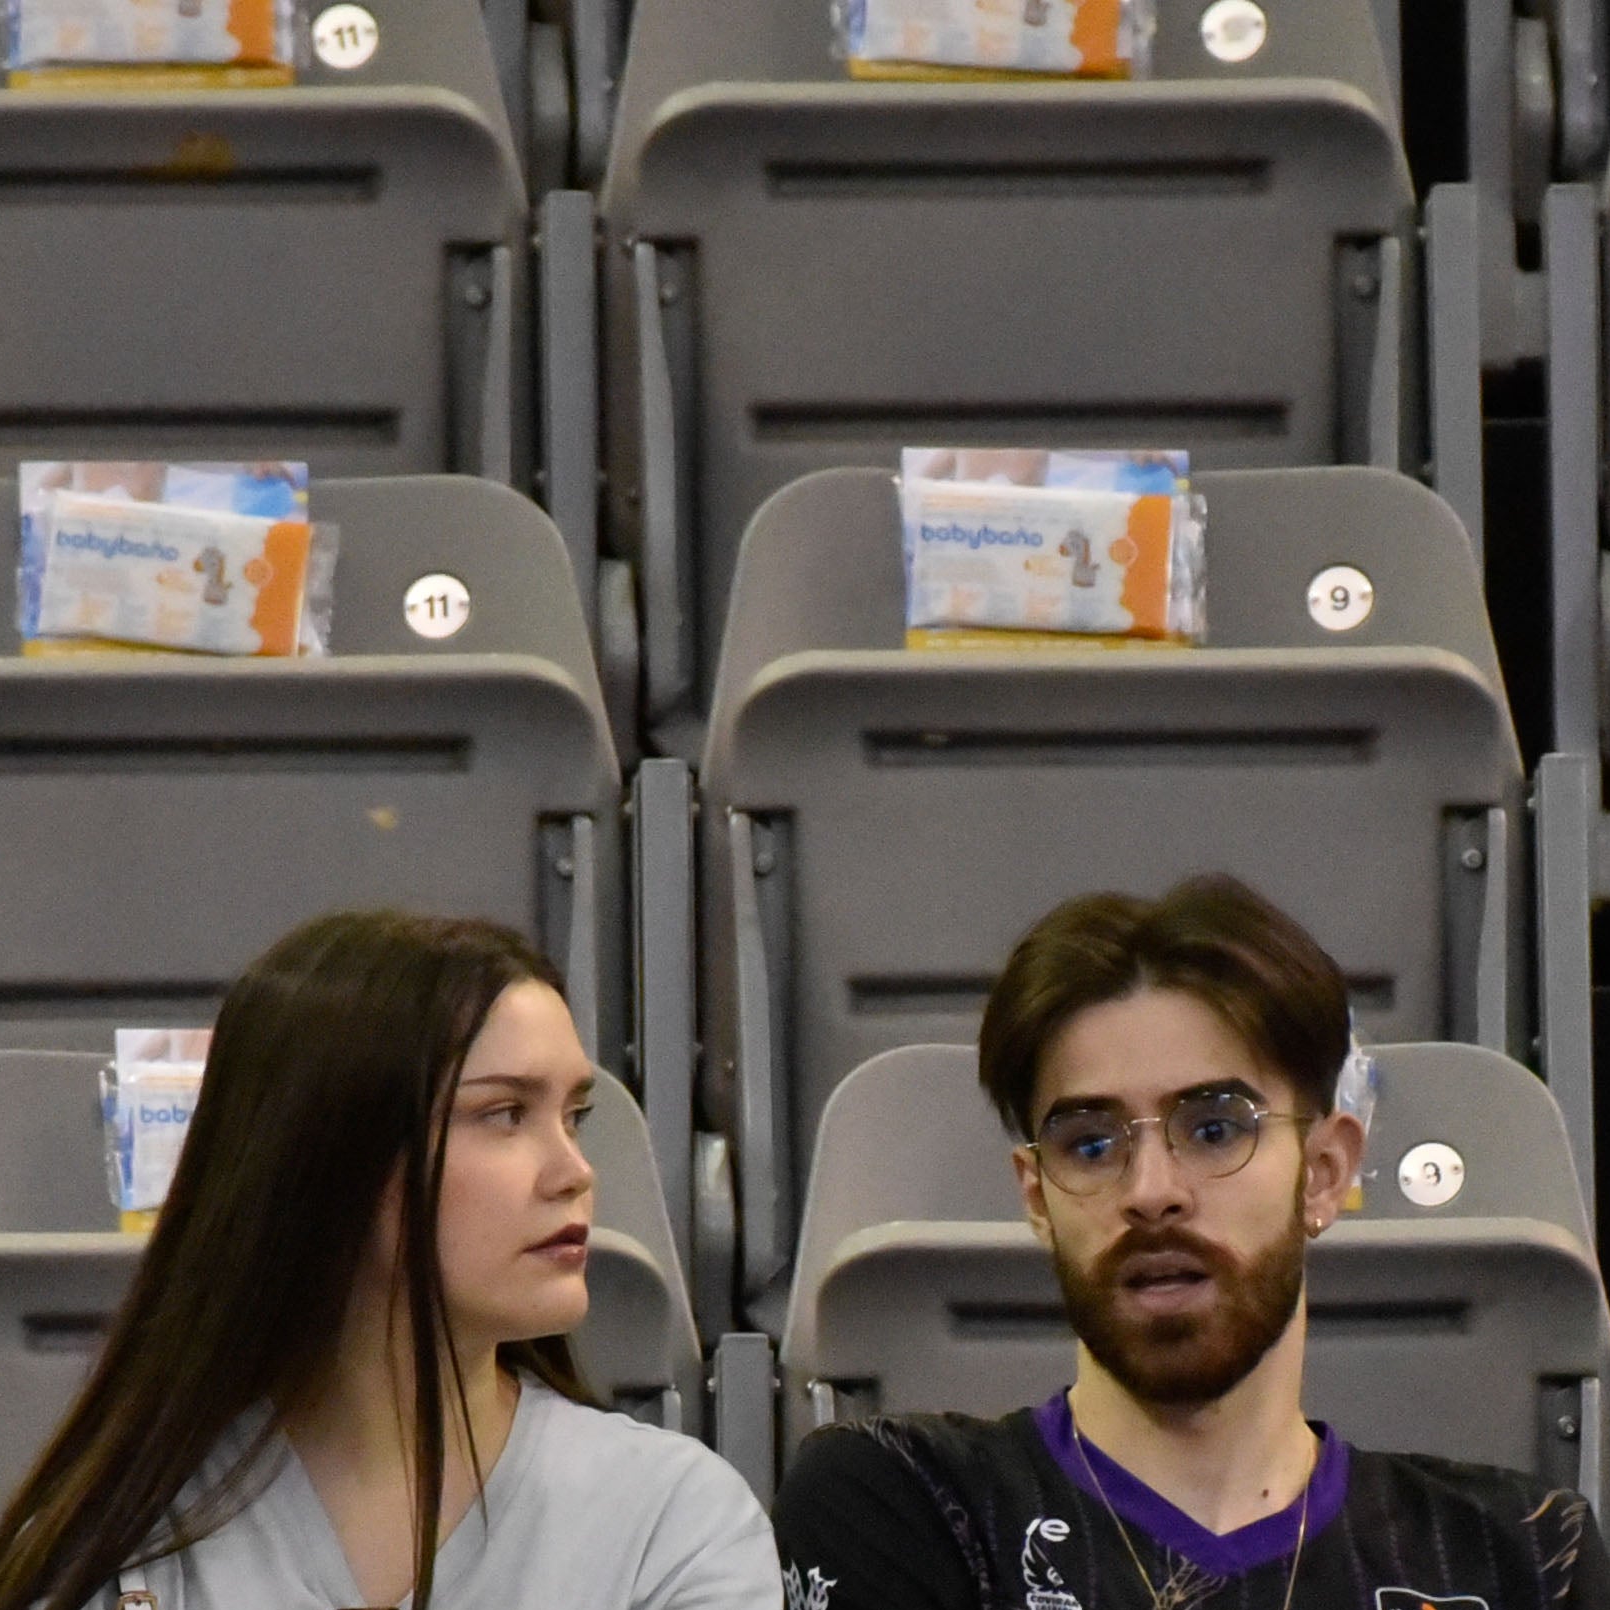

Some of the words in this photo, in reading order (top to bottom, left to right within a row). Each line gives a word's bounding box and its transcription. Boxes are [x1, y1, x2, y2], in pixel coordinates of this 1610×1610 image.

[334, 25, 360, 50] 11
[921, 523, 1043, 549] babybaño
[424, 594, 449, 620] 11
[1330, 586, 1350, 611] 9
